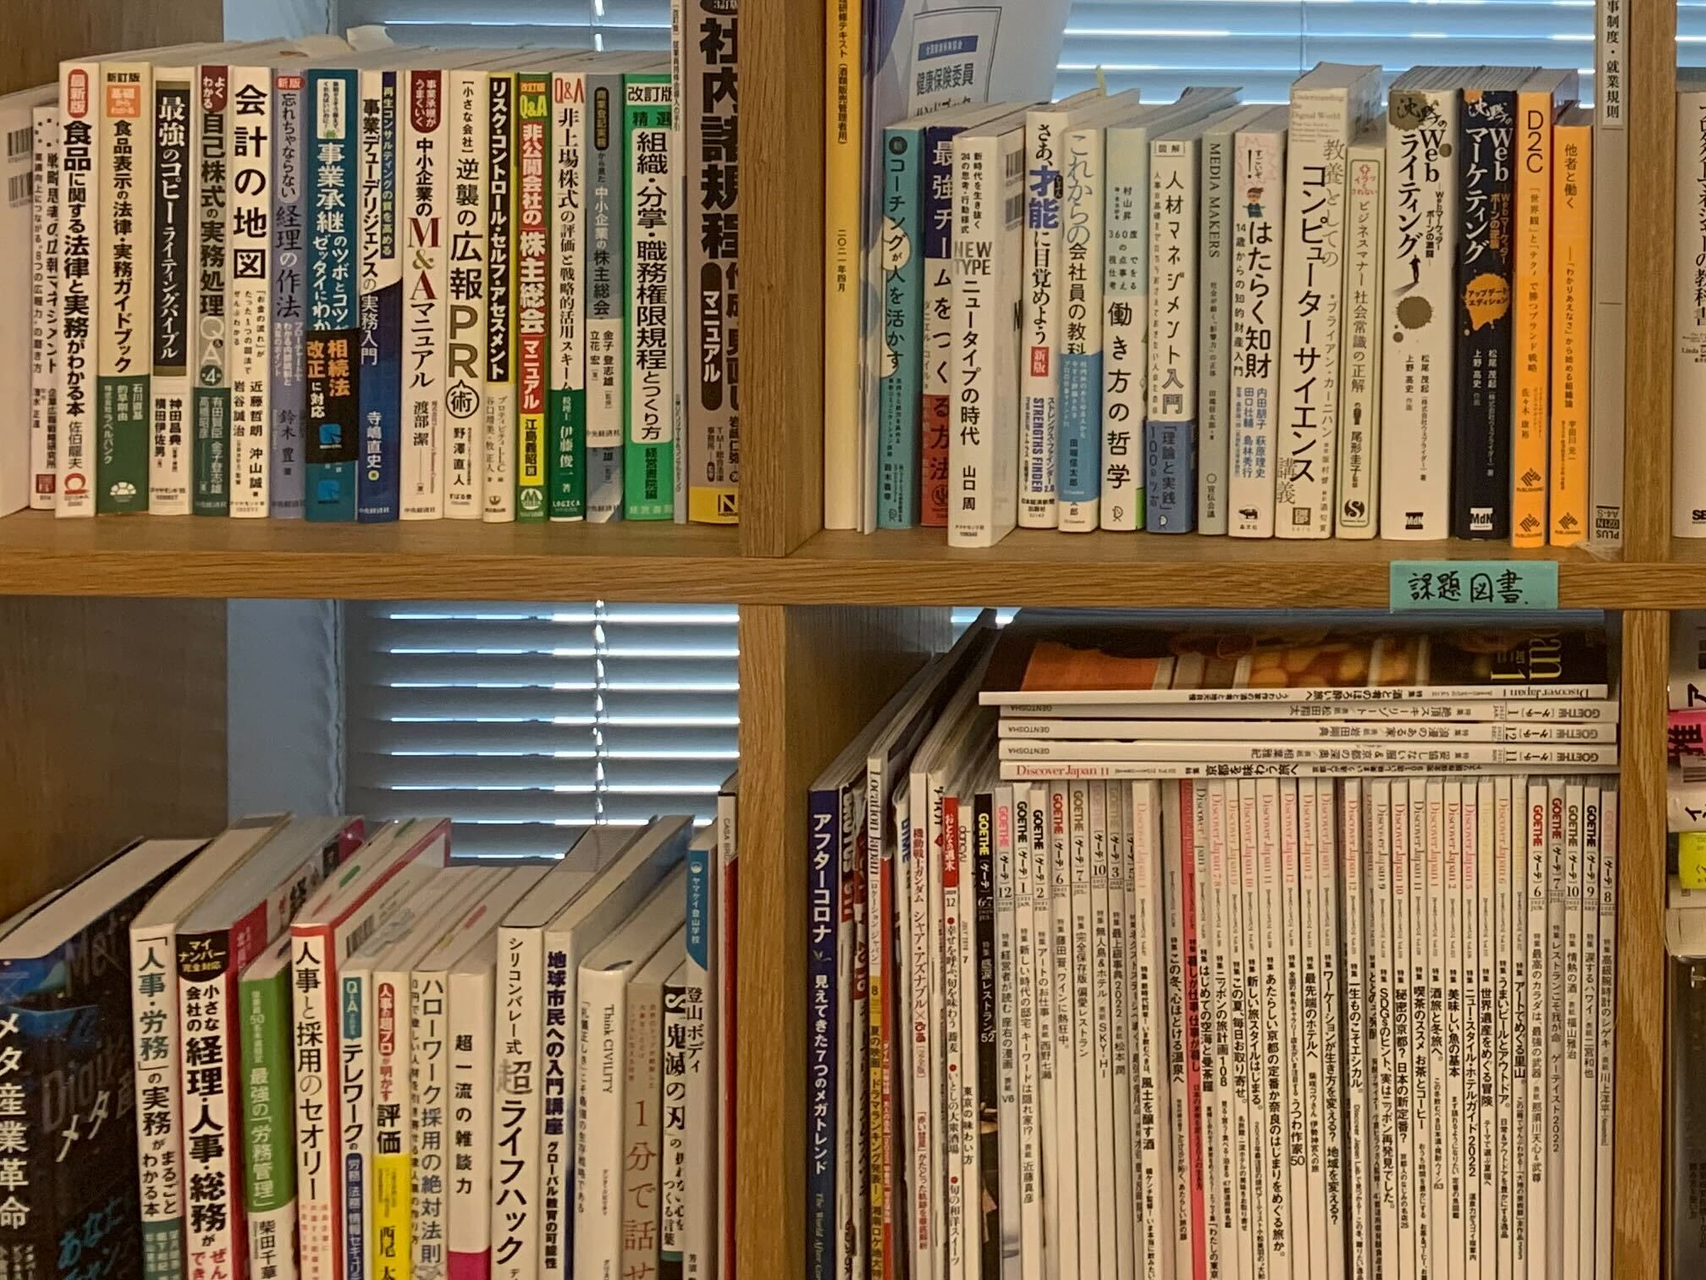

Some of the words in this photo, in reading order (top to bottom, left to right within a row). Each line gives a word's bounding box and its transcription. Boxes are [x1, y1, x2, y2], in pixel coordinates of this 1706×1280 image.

[281, 92, 297, 197] 忘れちゃならない
[915, 62, 975, 96] 健康保険委員
[1526, 110, 1545, 174] D2C
[233, 83, 268, 280] 会計の地図
[1208, 142, 1222, 195] MEDIA
[1397, 134, 1424, 259] ライティング
[1422, 129, 1444, 183] Web
[1465, 127, 1490, 264] マーケティング
[1563, 144, 1579, 209] 他者と働く
[63, 121, 92, 417] 食品に関する法律と実務がわかる本
[112, 121, 132, 373] 食品表示の法律・実務ガイドブック
[158, 97, 185, 360] 最強のコピーライティングバイブル
[276, 204, 301, 319] 経理の作法
[490, 81, 507, 380] リスク・コントロール・セルフ・アセスメント
[635, 131, 668, 441] 組織・分掌・職務権限規程とつくり方
[885, 158, 906, 369] コーチングが人を活かす
[954, 241, 991, 258] NEW
[954, 257, 991, 275] TYPE
[1162, 170, 1185, 414] 人材マネジメント入門
[1208, 199, 1220, 259] MAKERS
[960, 280, 981, 447] ニュータイプの時代
[1234, 224, 1246, 377] 14歳からの知的財産入門
[1246, 223, 1272, 379] はたらく知財
[1293, 166, 1326, 483] コンピューターサイエンス
[327, 339, 349, 397] 相続法
[1105, 301, 1132, 490] 働き方の哲学
[453, 426, 466, 487] 野澤直人
[1408, 572, 1522, 603] 課題図書
[812, 813, 833, 944] アフターコロナ
[977, 812, 991, 857] GOETHE
[1016, 801, 1029, 843] GOETHE
[295, 942, 325, 1201] 人事と採用のセオリー
[544, 951, 568, 1135] 地球市民への入門講座
[813, 974, 830, 1175] 見えてきた7つのメガトレンド
[1431, 987, 1444, 1062] 酒旅と冬旅へ。
[1481, 988, 1493, 1107] 世界遺産をめぐる冒険
[420, 978, 444, 1264] ハローワーク採用の絶対法則
[455, 1035, 473, 1196] 超一流の雑談力
